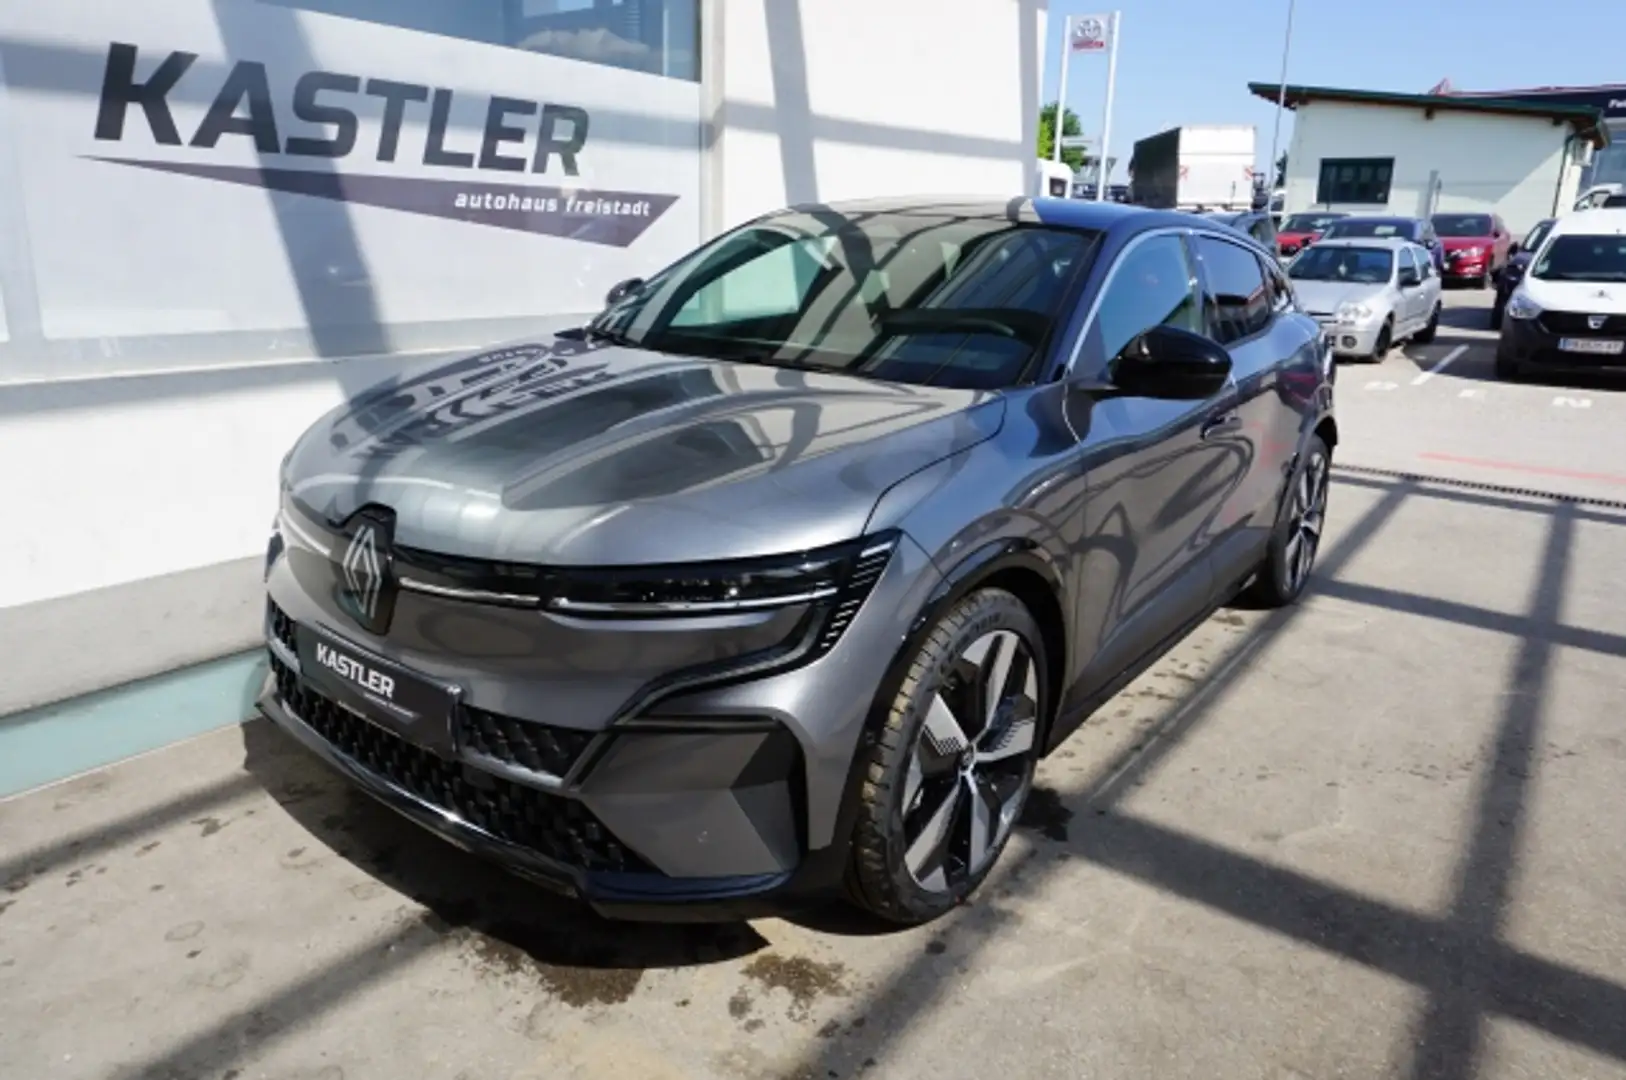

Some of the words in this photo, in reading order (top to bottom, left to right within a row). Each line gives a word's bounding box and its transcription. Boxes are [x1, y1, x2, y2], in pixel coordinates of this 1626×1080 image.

[94, 42, 590, 176] KASTLER
[454, 192, 557, 213] autohaus
[564, 196, 650, 216] freistadt
[316, 642, 395, 699] KASTLER
